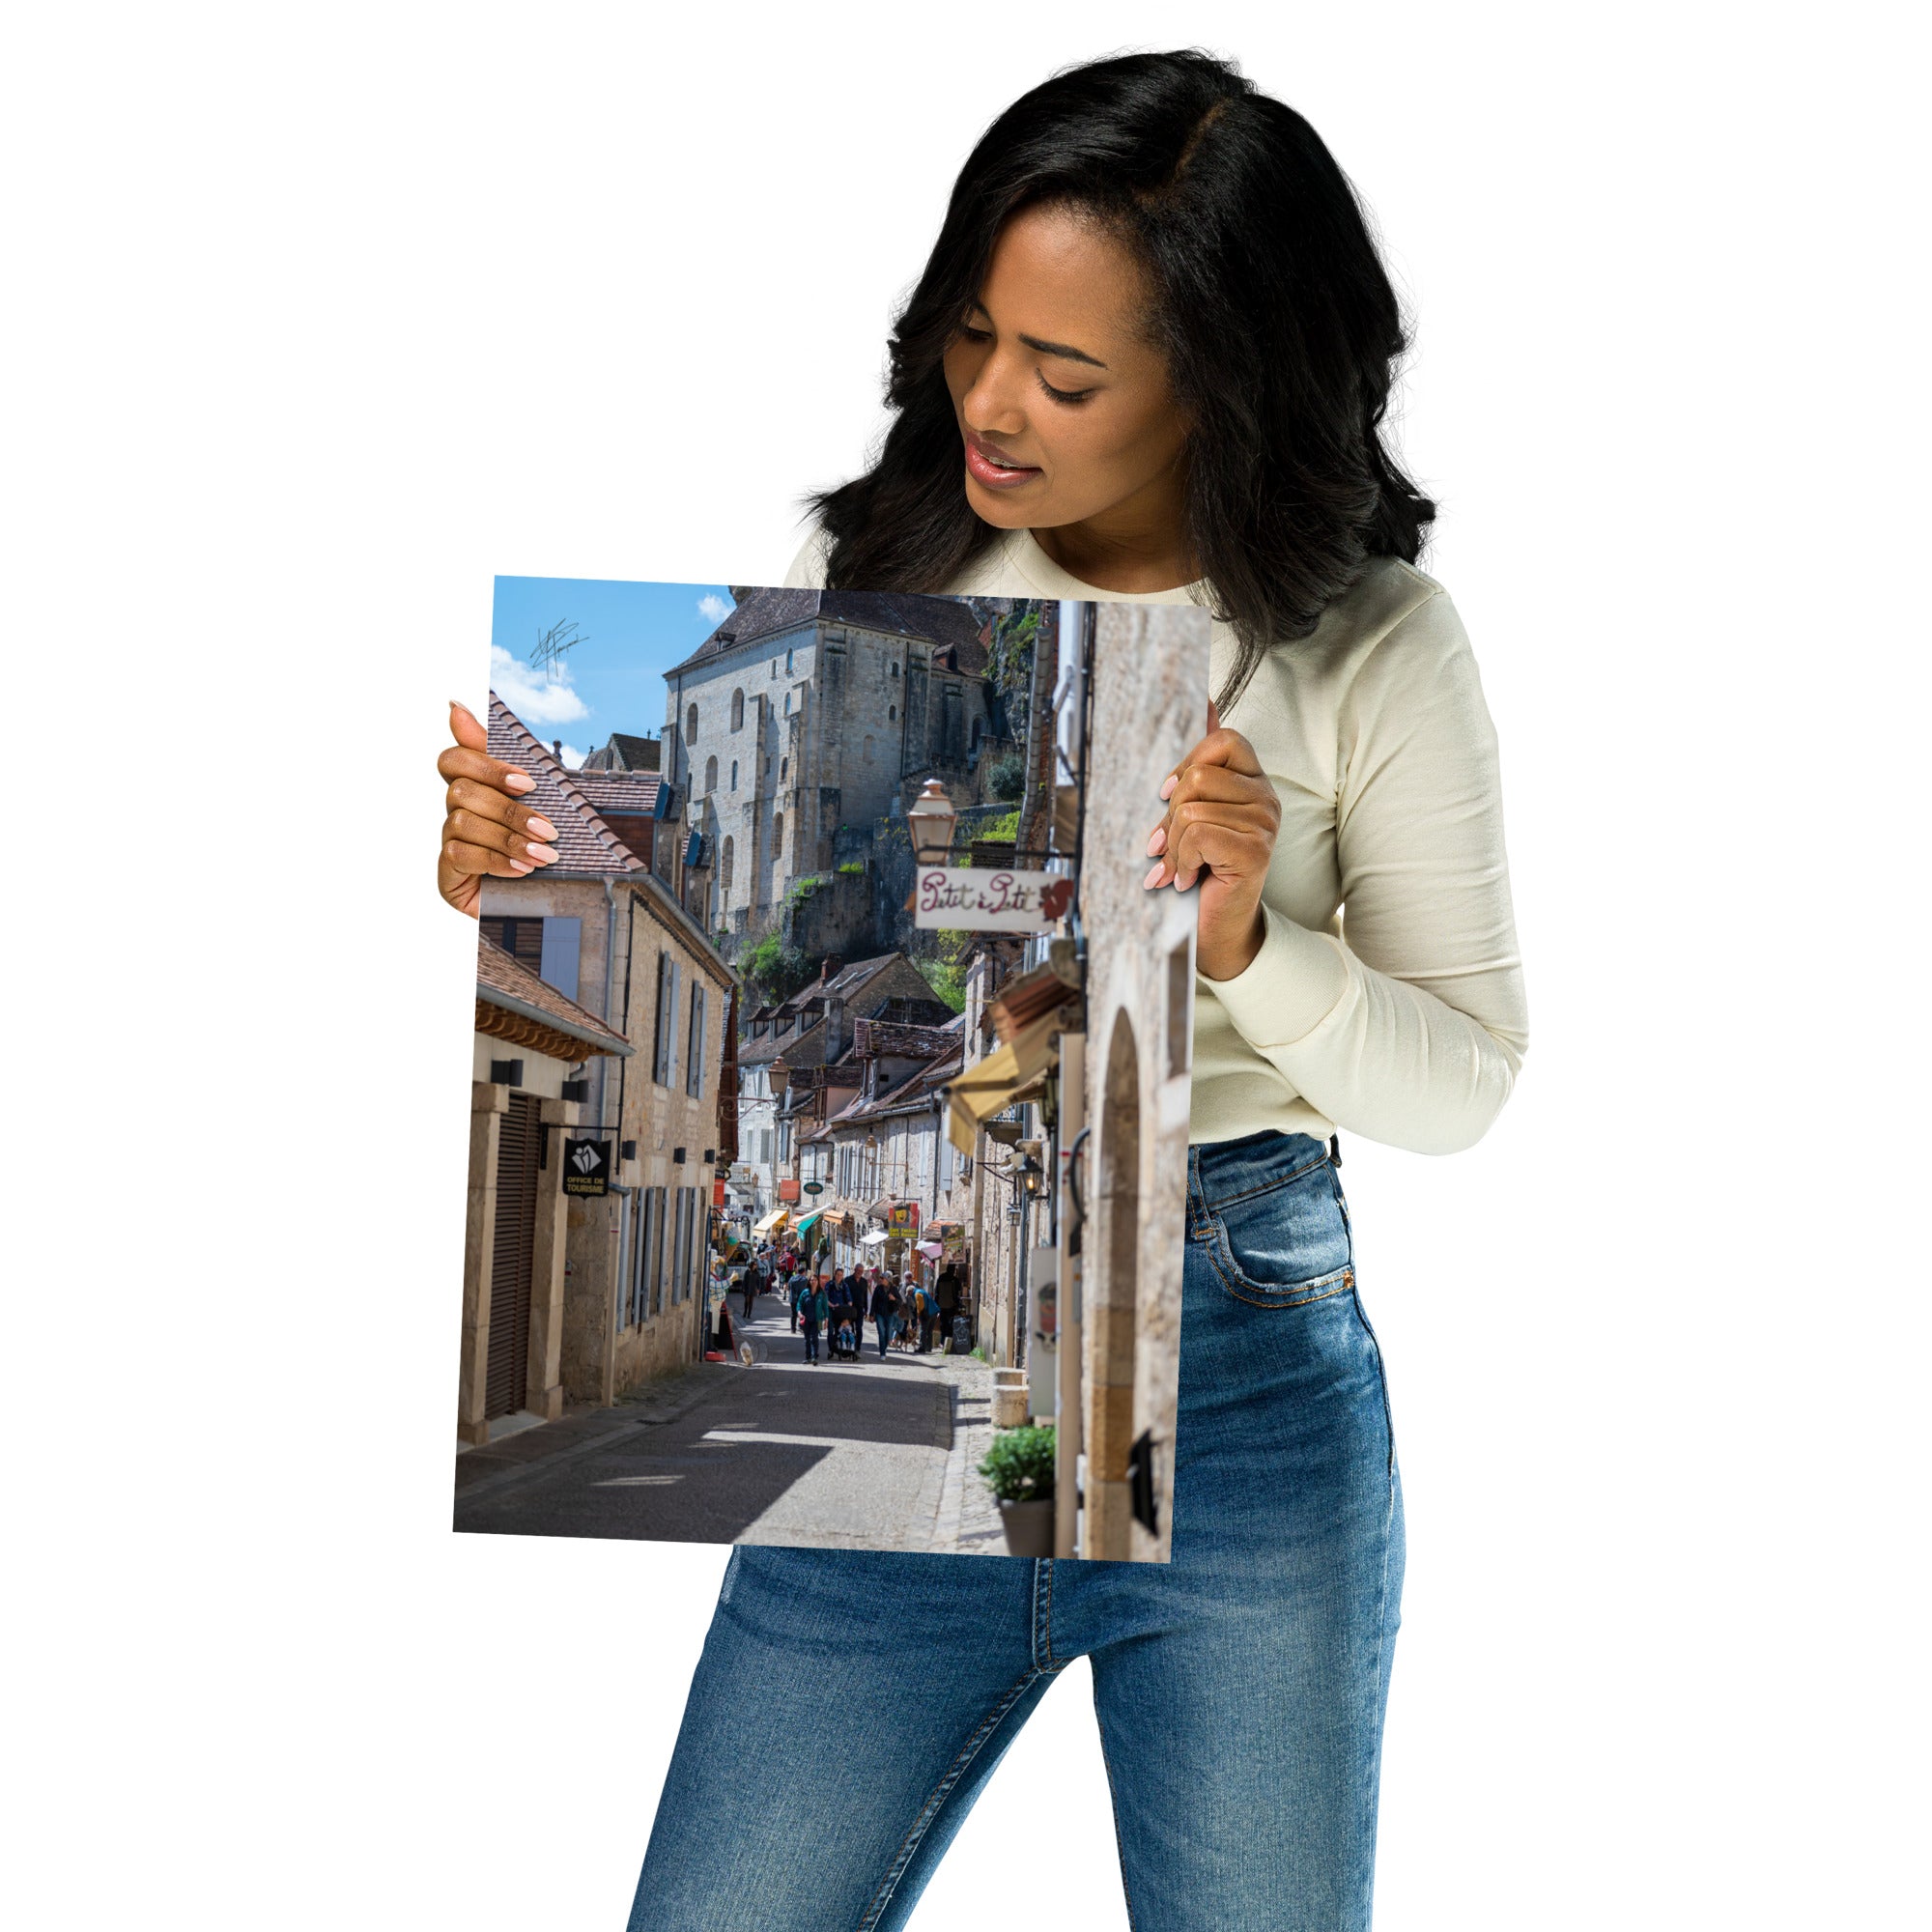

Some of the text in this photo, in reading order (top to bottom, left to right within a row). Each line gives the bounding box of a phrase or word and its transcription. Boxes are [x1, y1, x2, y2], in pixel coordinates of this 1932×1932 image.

[921, 871, 976, 912] Petit
[988, 872, 1036, 914] Petit
[567, 1184, 604, 1193] TOURISME
